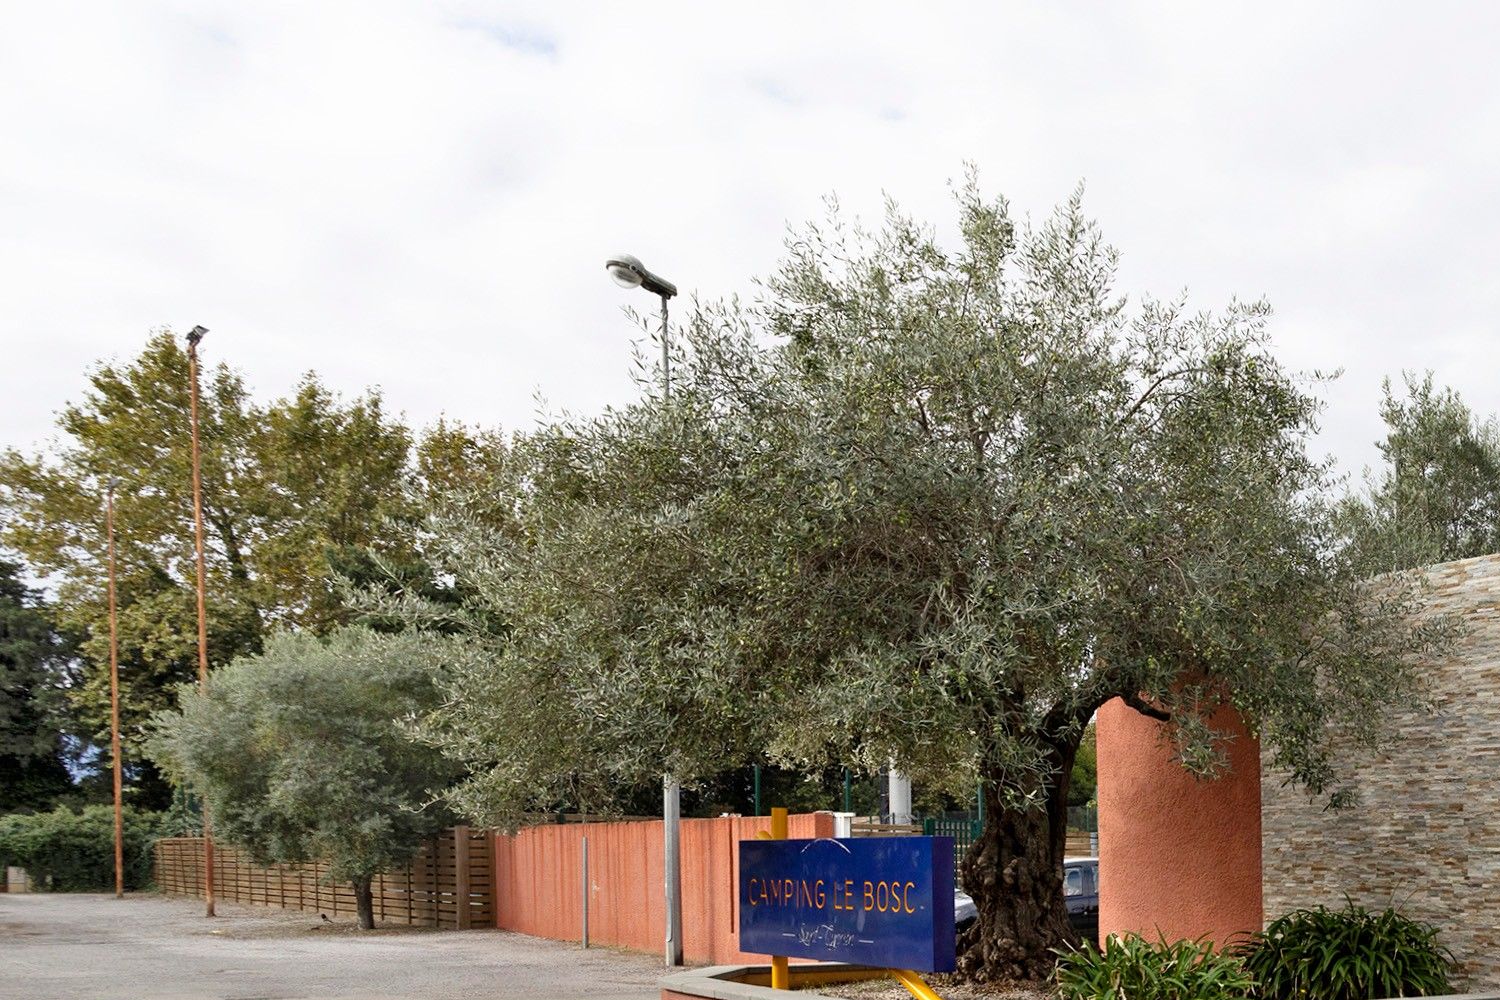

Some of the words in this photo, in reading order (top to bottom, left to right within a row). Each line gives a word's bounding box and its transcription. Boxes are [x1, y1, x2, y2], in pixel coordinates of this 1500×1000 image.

[749, 878, 825, 909] CAMPING
[833, 879, 853, 910] LE
[864, 881, 915, 914] BOSC
